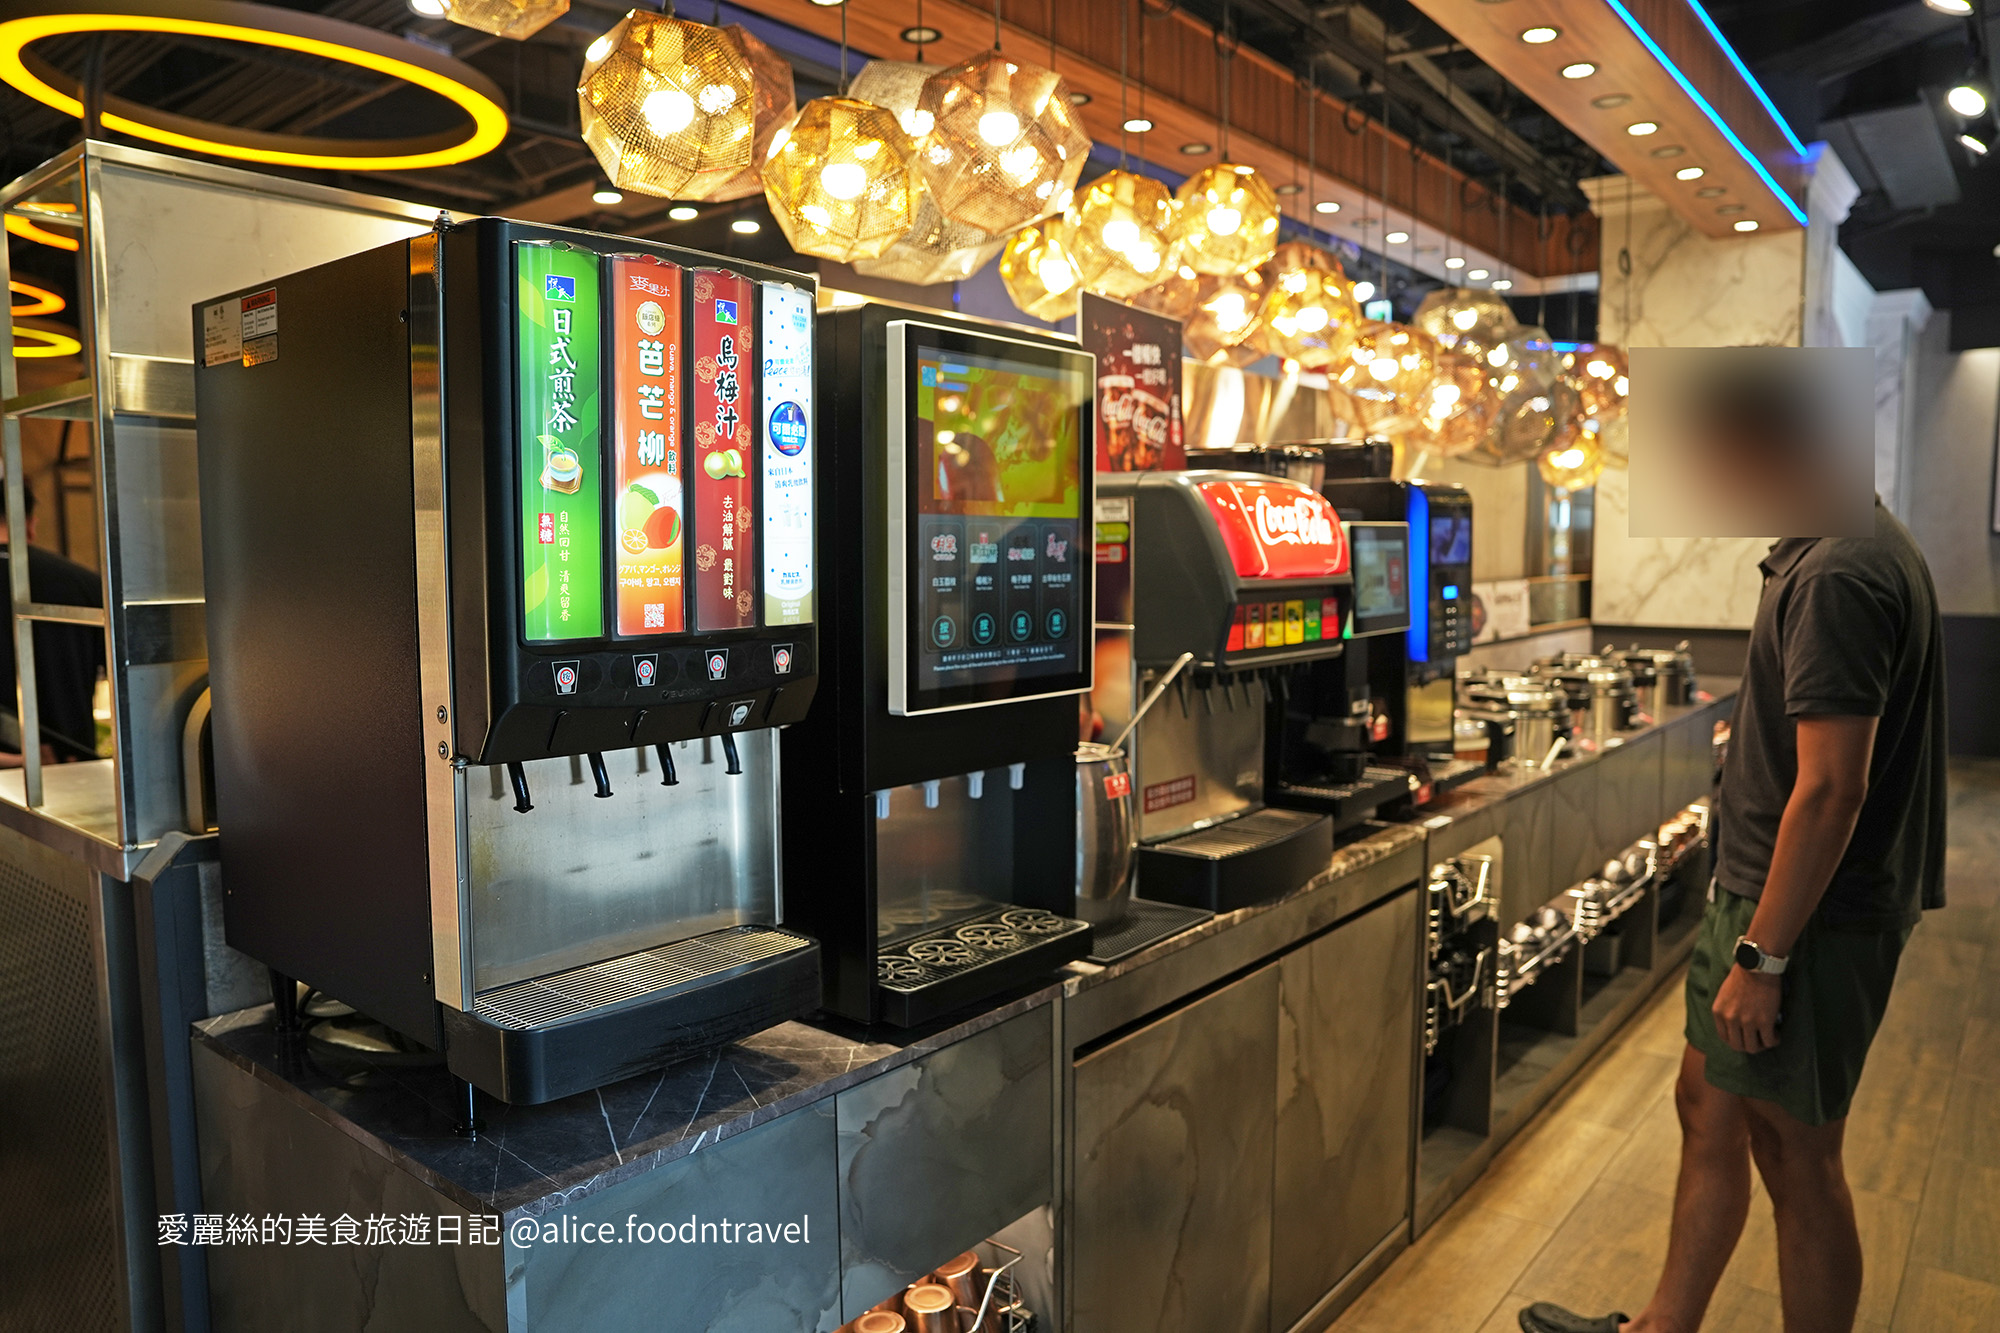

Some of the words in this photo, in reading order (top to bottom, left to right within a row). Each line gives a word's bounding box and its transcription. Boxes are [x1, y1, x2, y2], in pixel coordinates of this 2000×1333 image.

[548, 308, 578, 433] 日式煎茶
[669, 344, 677, 373] Guava,
[637, 339, 665, 467] 芭芒柳
[668, 375, 676, 406] mango
[714, 335, 739, 440] 烏梅汁
[668, 416, 676, 447] orange
[667, 449, 677, 475] 飲料
[539, 514, 554, 542] 無糖
[558, 510, 571, 562] 自然回甘
[722, 495, 735, 551] 去油解膩
[559, 570, 572, 622] 清爽留香
[722, 558, 735, 600] 最對味
